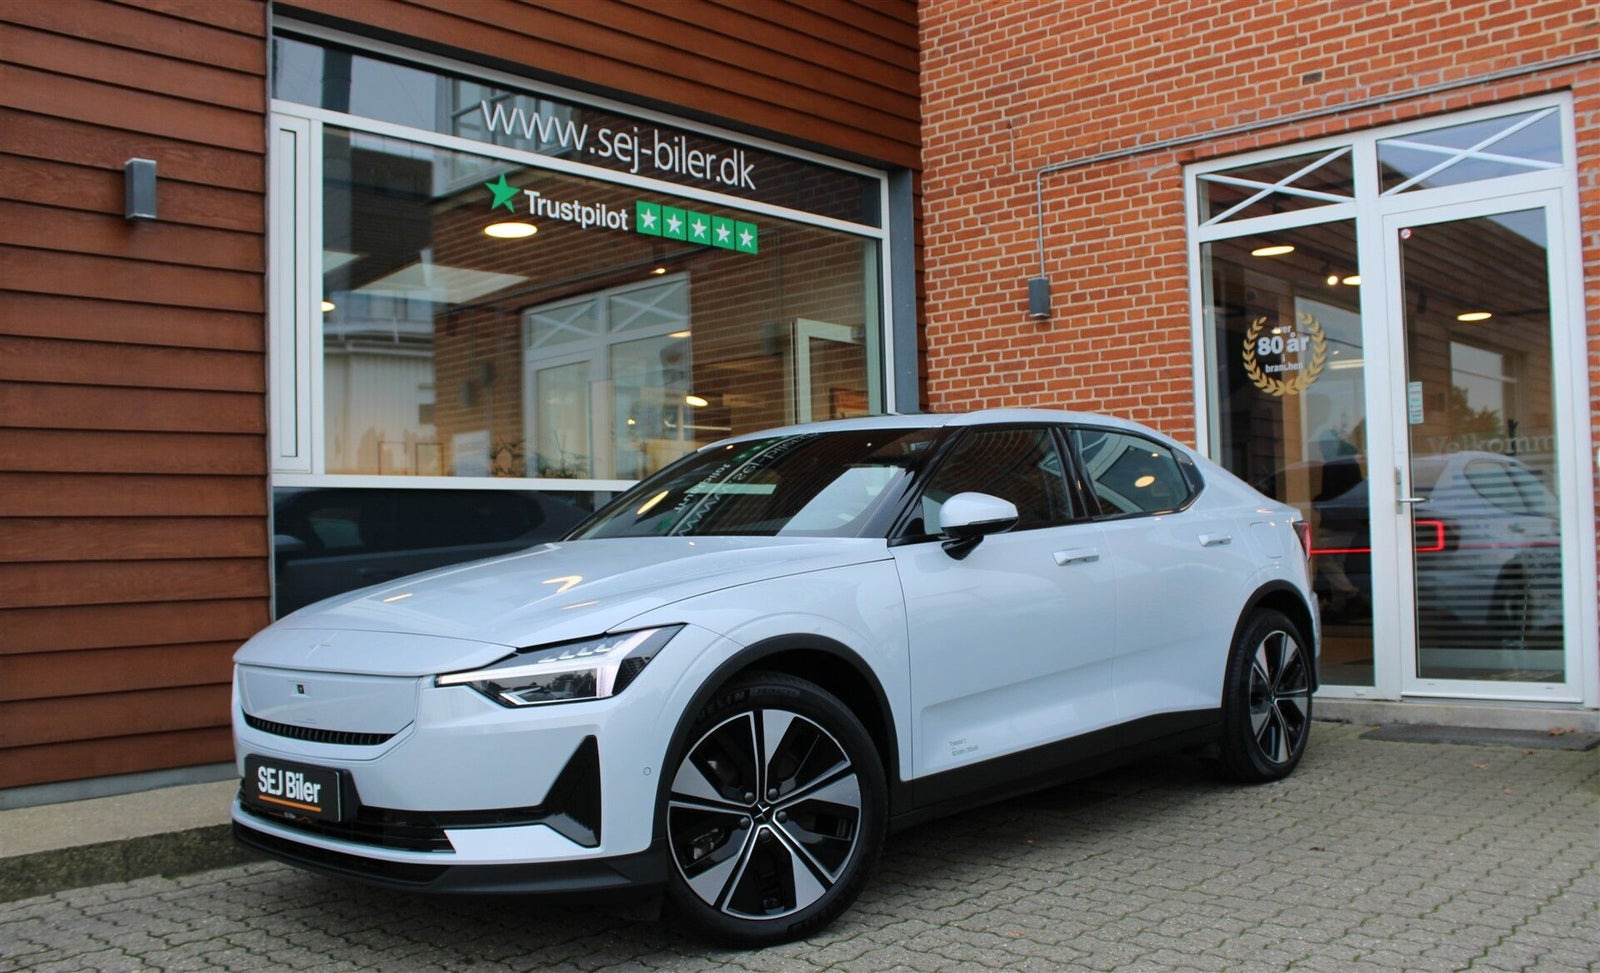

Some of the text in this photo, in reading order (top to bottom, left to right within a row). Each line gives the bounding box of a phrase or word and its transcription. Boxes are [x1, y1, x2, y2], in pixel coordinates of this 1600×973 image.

[481, 99, 757, 190] www.sej-biler.dk
[523, 189, 629, 231] Trustpilot
[1257, 332, 1309, 356] 80 år
[257, 766, 321, 804] SEJ Biler
